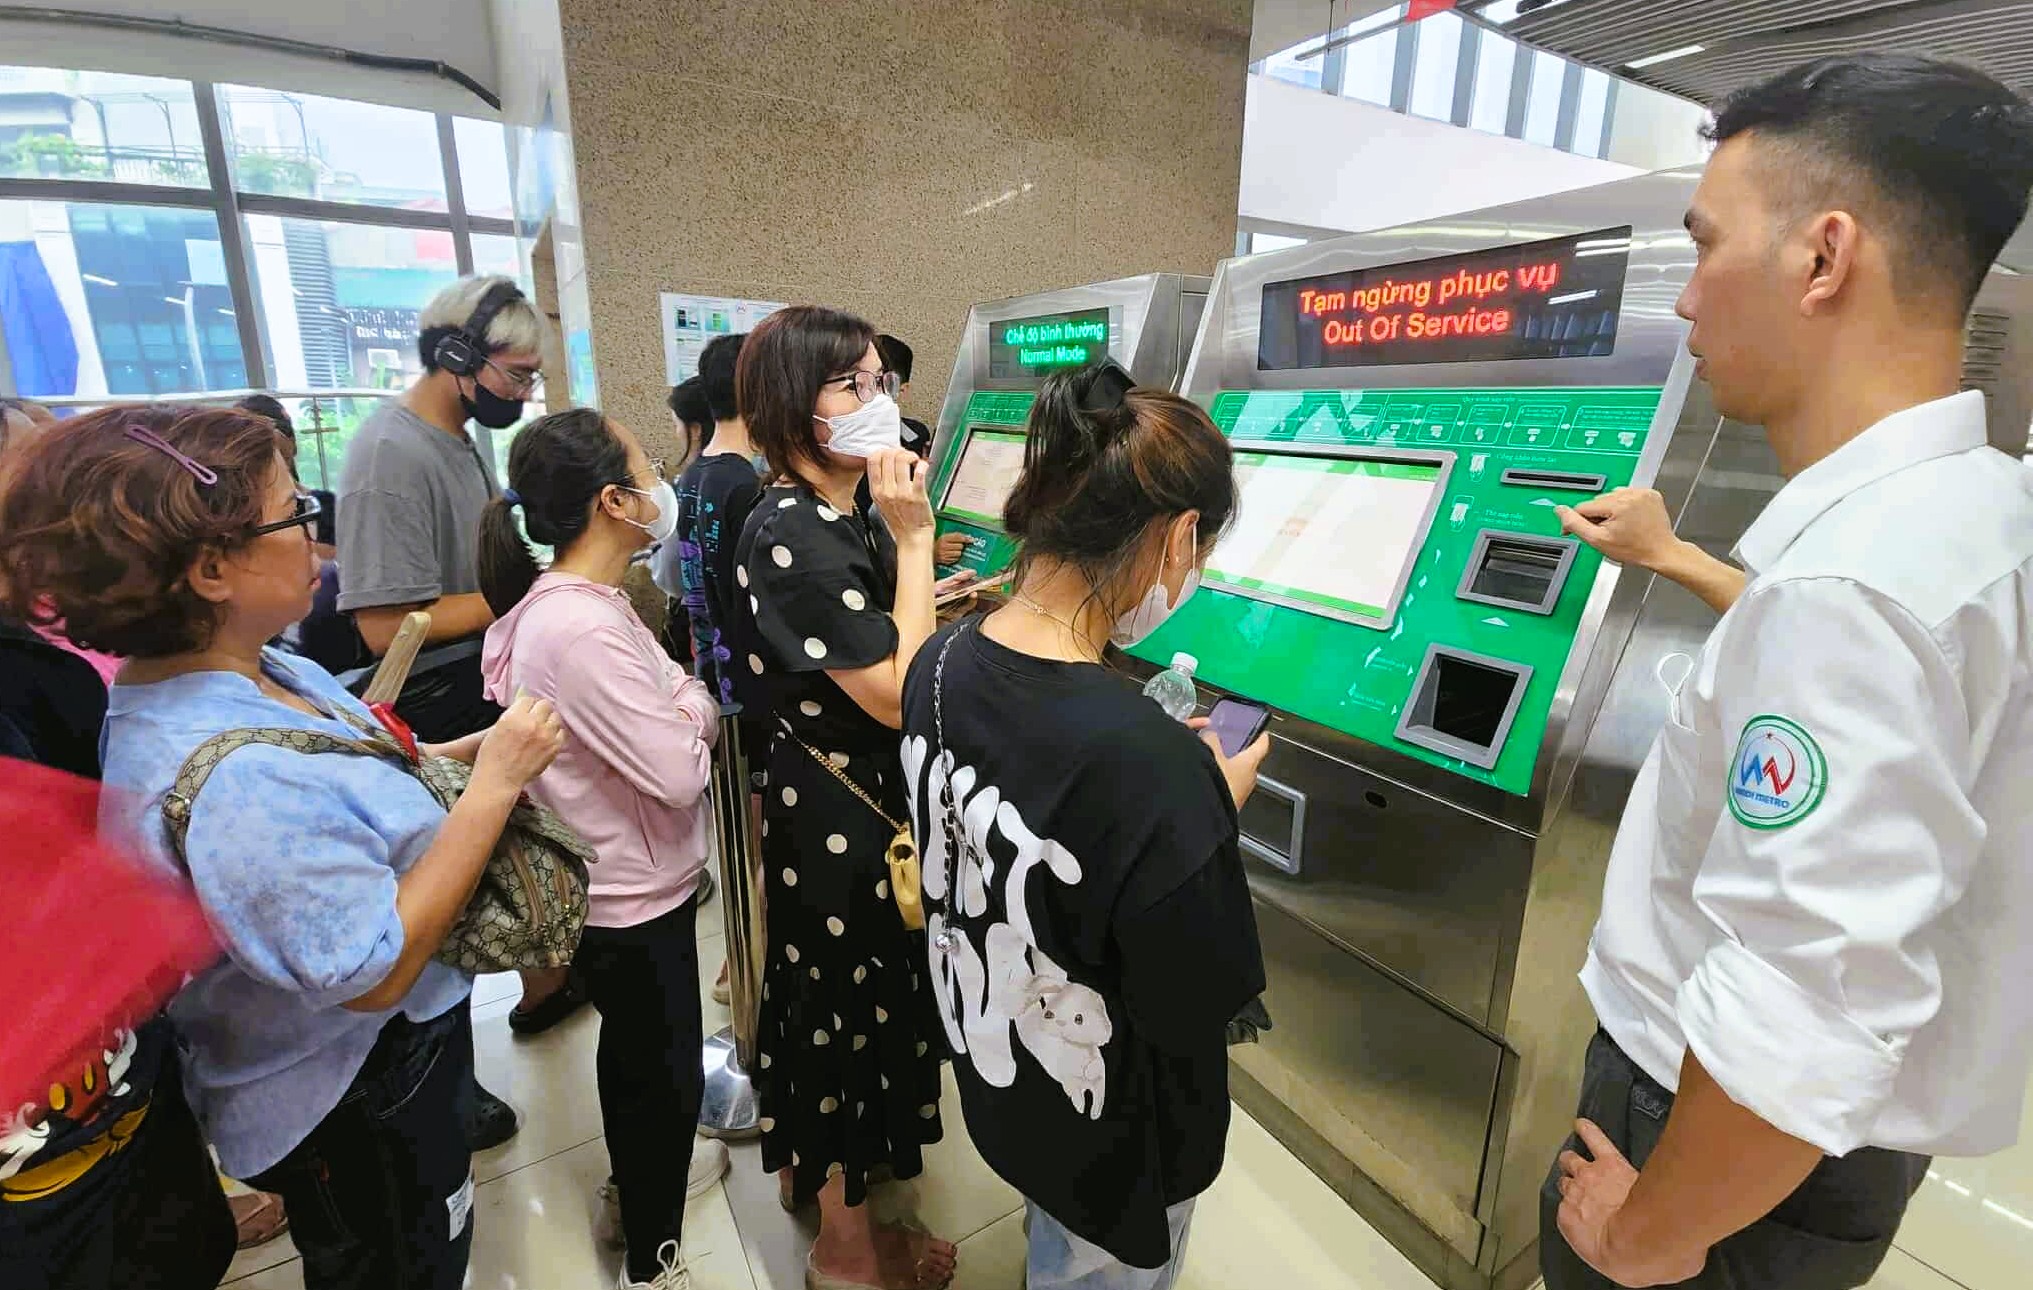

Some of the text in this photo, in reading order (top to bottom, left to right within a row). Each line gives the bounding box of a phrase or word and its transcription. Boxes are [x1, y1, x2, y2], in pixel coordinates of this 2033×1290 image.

[1301, 263, 1558, 315] Tạm ngừng phục vụ
[1006, 321, 1105, 345] Chế độ bình thường
[1324, 307, 1510, 345] Out Of Service
[1020, 344, 1087, 365] Normal Mode
